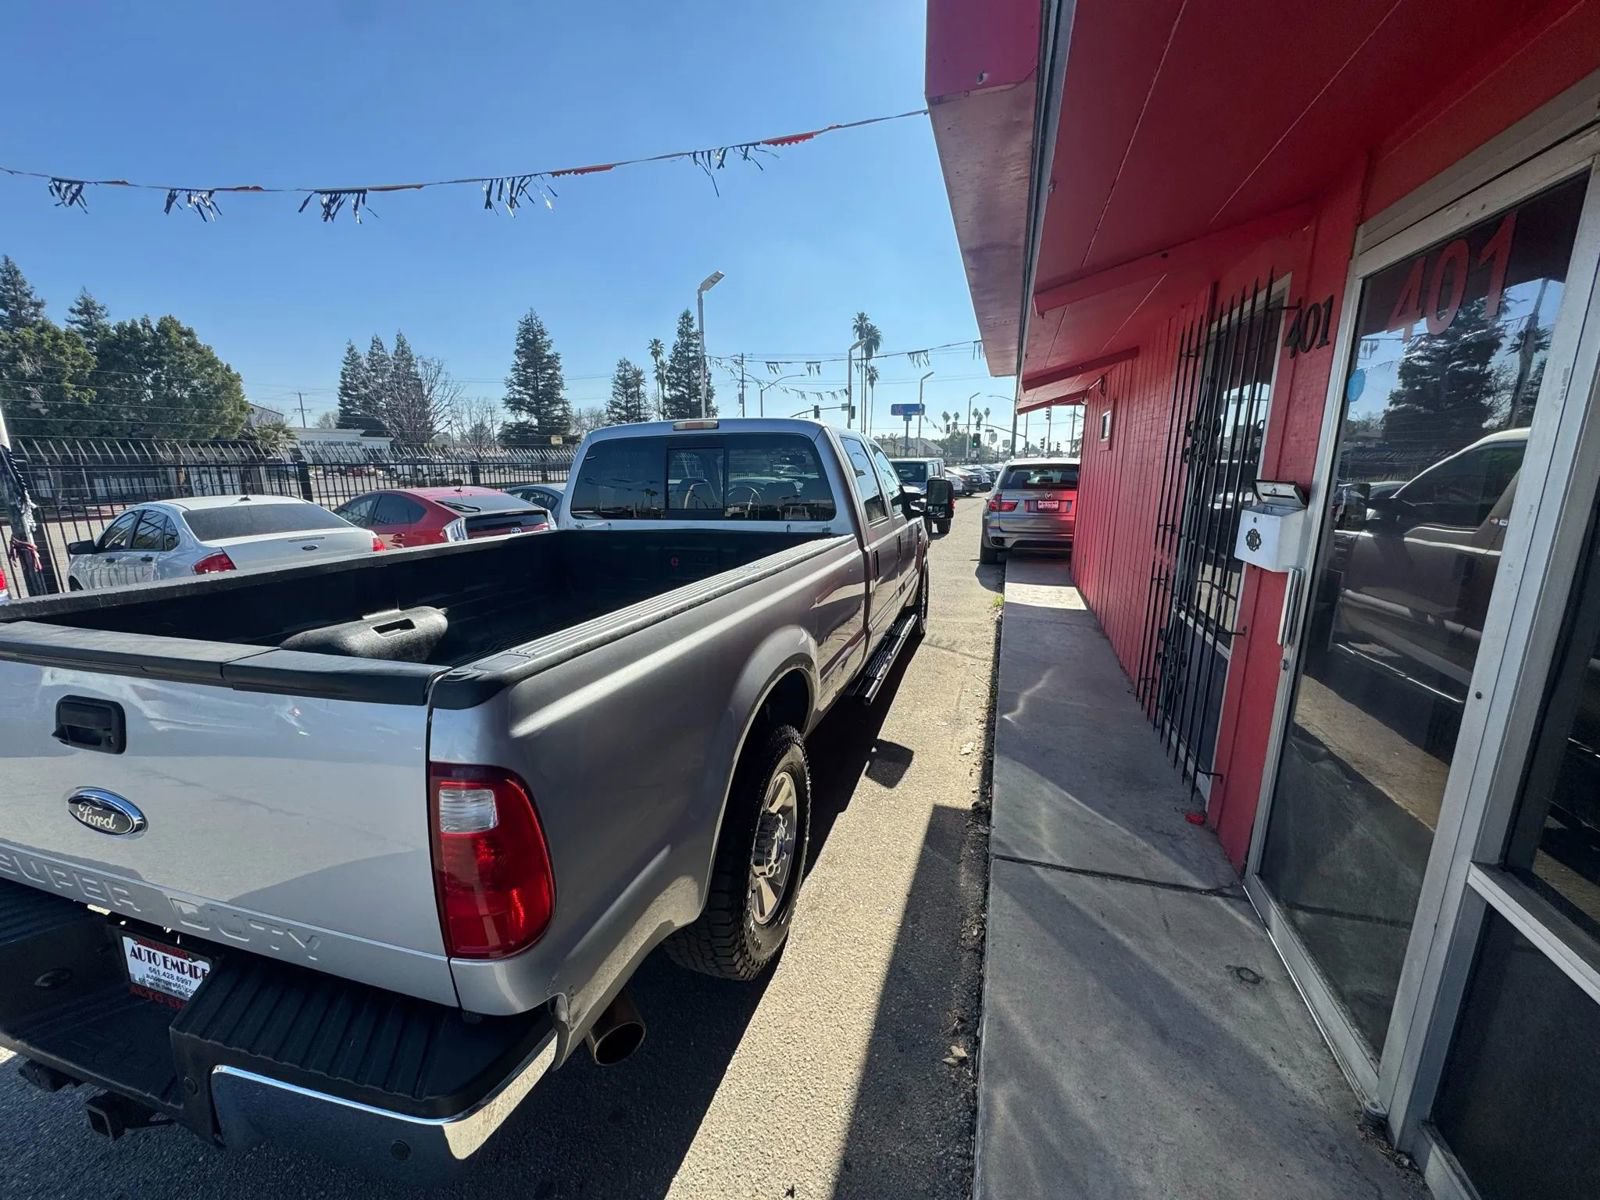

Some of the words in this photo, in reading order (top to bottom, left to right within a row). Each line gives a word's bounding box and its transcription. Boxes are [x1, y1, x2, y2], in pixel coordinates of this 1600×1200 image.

[1387, 208, 1518, 344] 401
[1284, 295, 1334, 359] 401
[77, 801, 117, 830] Ford
[130, 946, 160, 966] AUTO
[168, 897, 321, 961] DUTY
